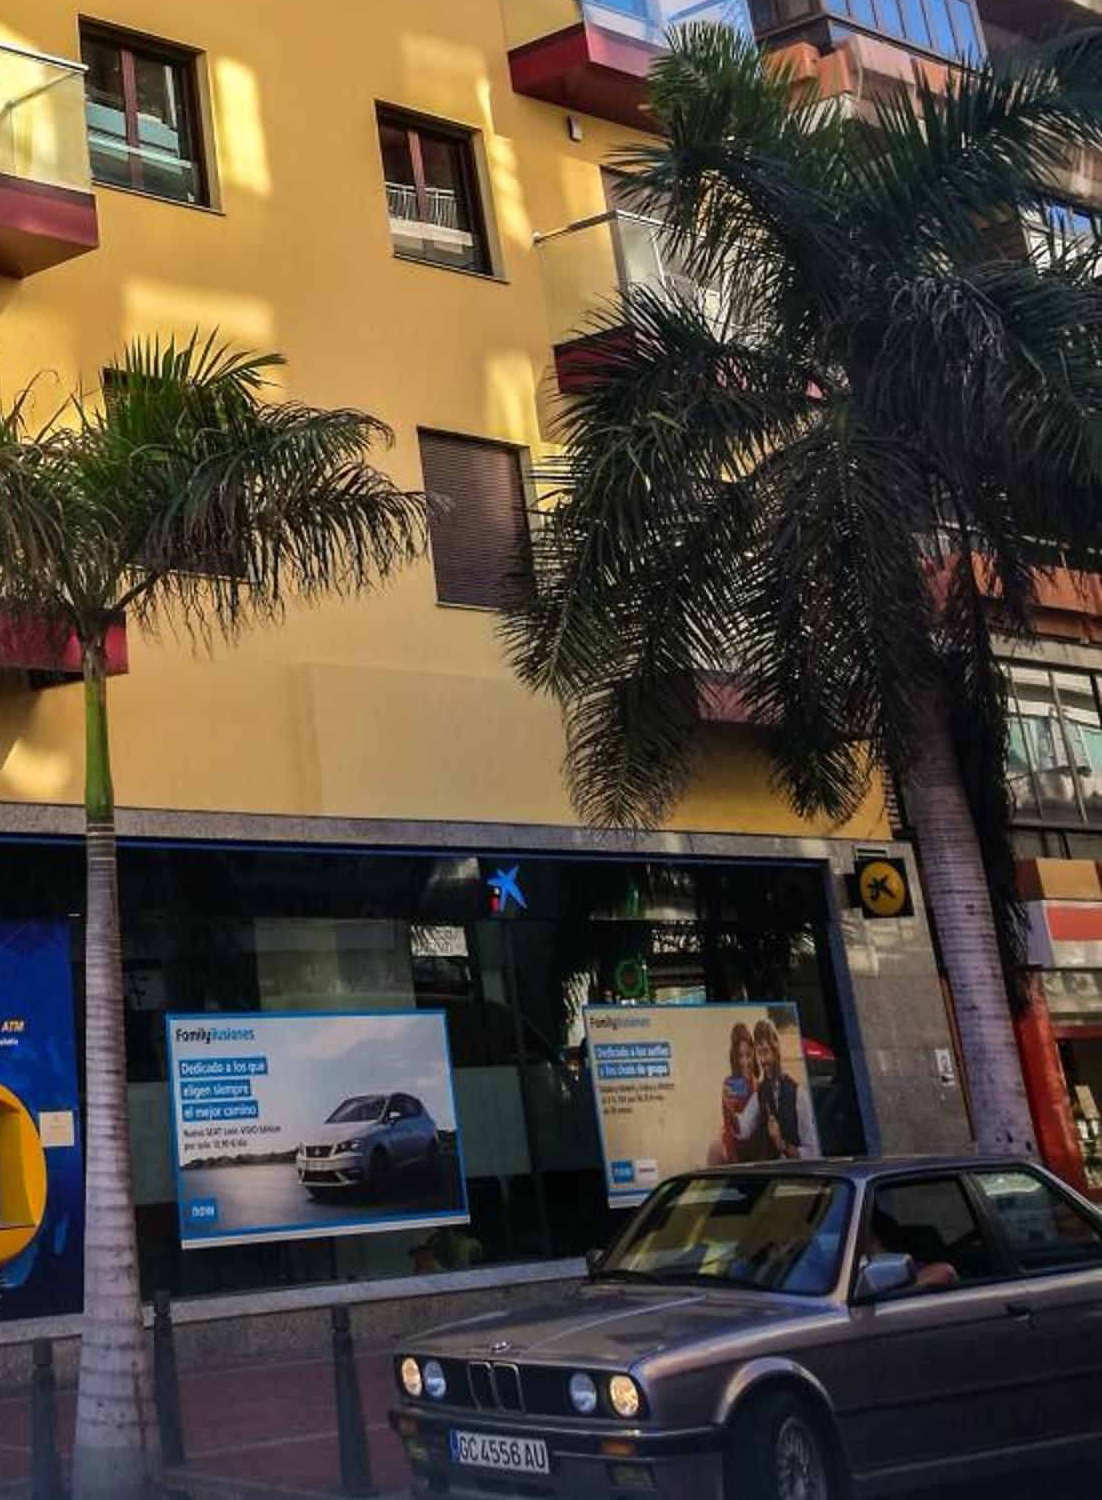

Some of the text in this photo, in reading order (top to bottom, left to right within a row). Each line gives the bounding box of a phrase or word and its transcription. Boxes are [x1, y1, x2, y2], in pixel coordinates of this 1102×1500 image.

[1, 1020, 25, 1033] ATM
[459, 1435, 478, 1461] GC
[524, 1442, 546, 1469] AU
